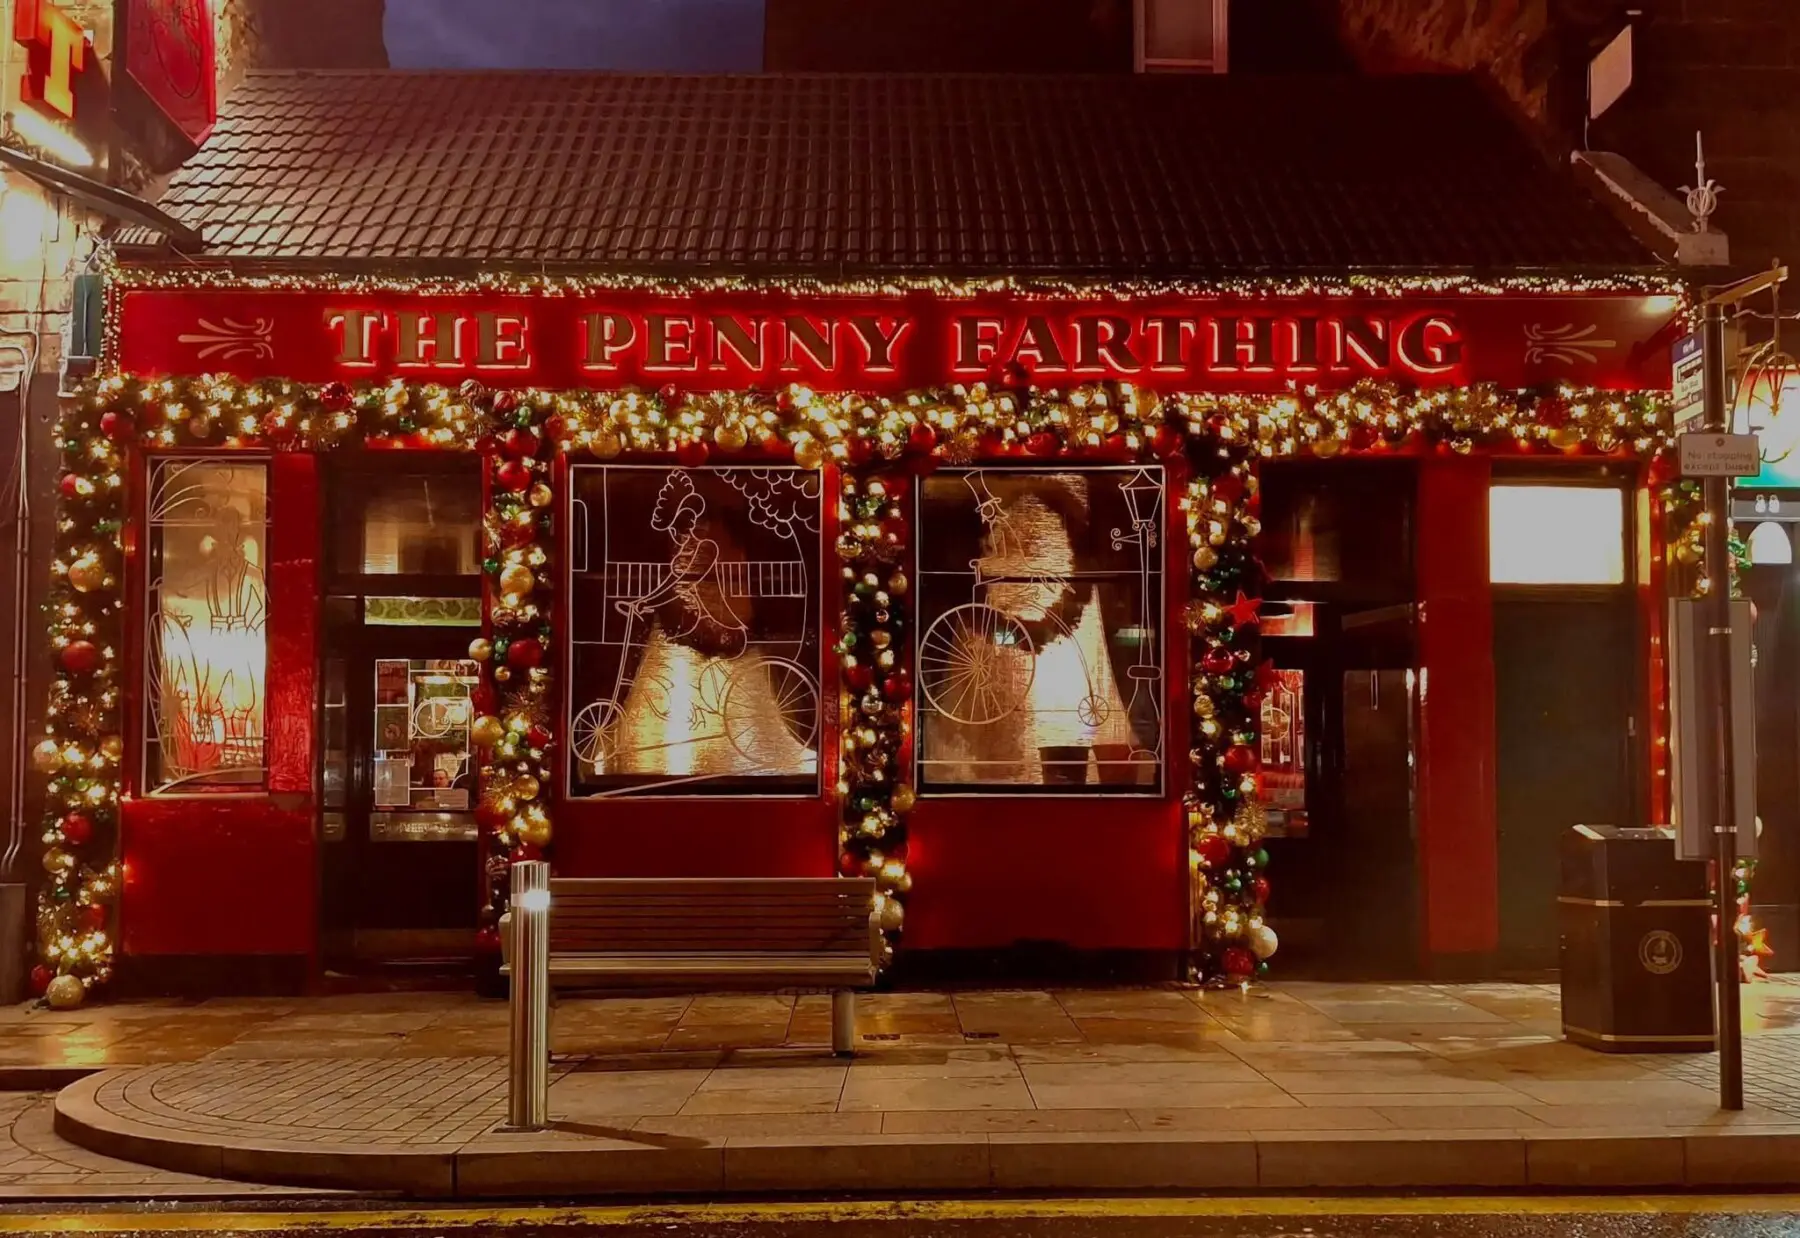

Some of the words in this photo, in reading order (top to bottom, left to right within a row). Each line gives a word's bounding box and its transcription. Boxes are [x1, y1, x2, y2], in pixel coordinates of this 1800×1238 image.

[323, 307, 533, 370] THE
[579, 311, 910, 372] PENNY
[951, 311, 1464, 374] FARTHING
[1688, 450, 1702, 460] No
[1725, 462, 1757, 472] buses
